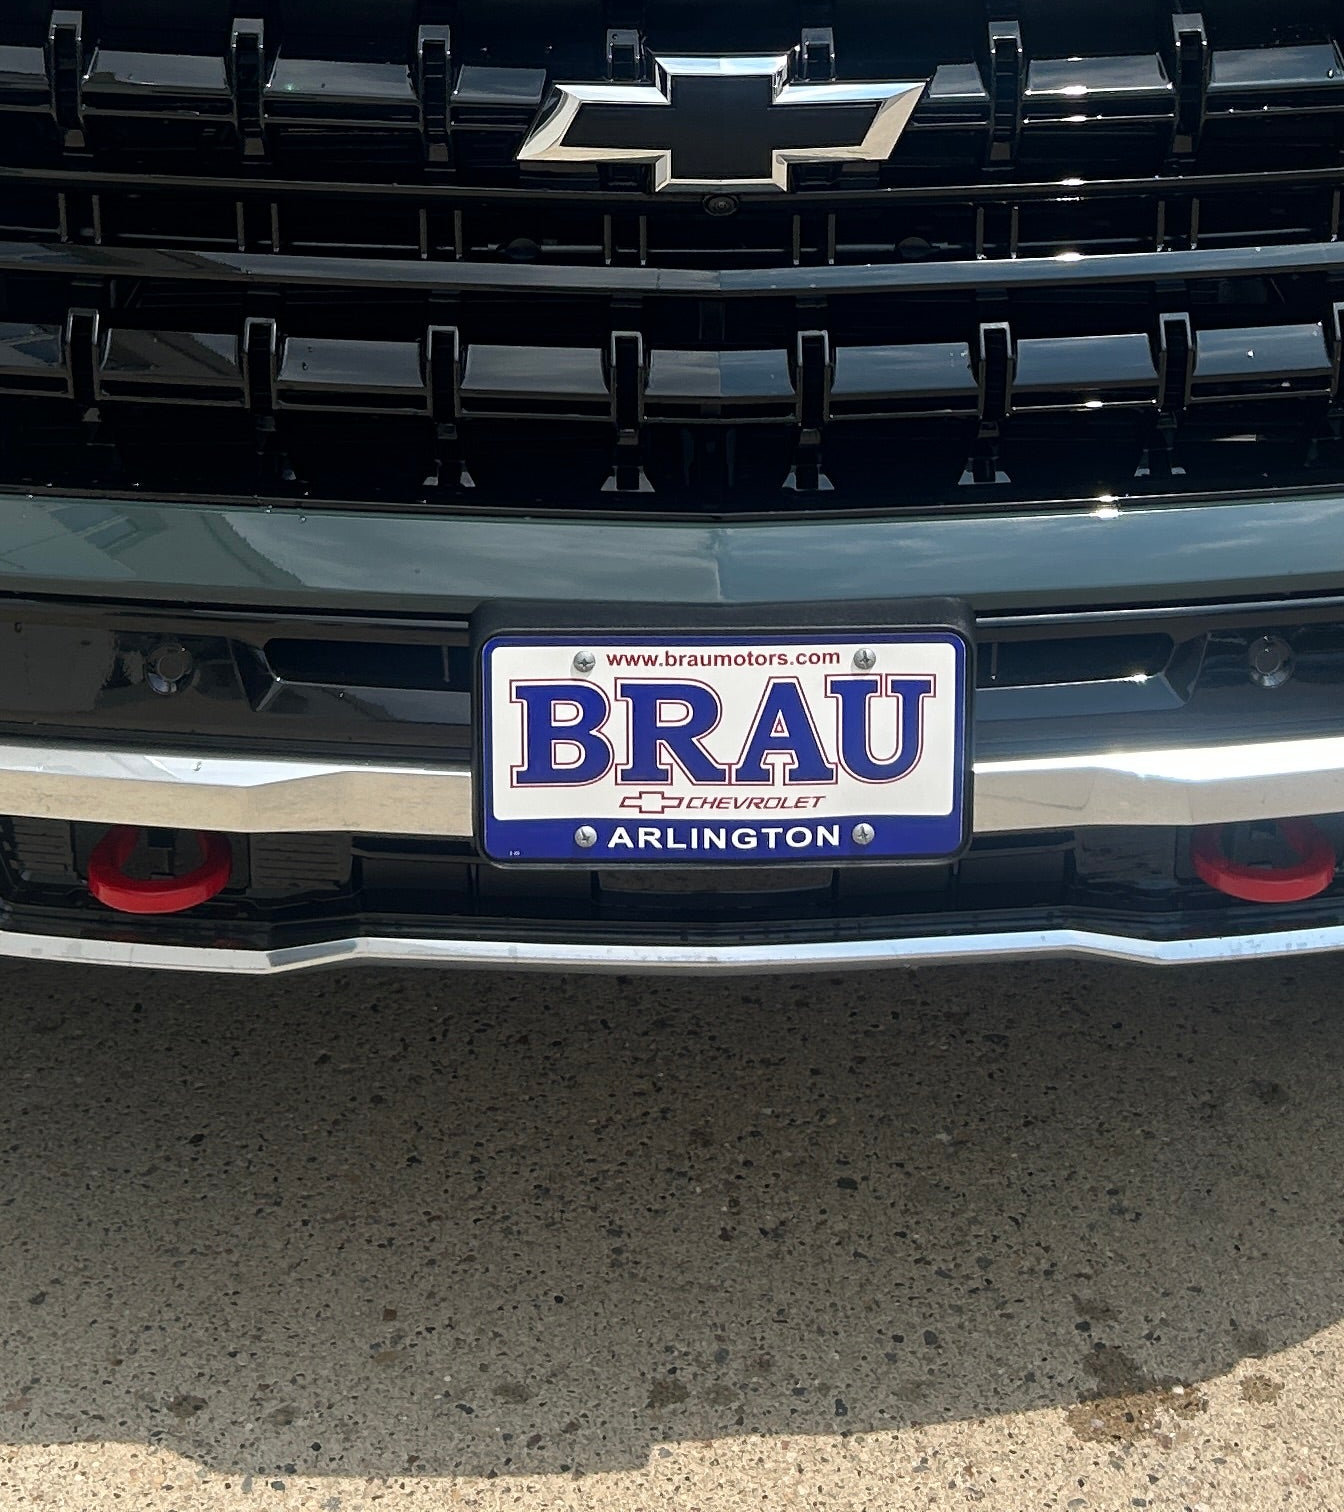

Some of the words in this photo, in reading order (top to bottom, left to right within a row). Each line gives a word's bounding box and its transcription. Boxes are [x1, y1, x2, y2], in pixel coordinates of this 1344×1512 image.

[606, 649, 841, 668] www.braumotors.com
[509, 674, 937, 788] BRAU
[686, 795, 827, 810] CHEVROLET
[607, 824, 841, 850] ARLINGTON
